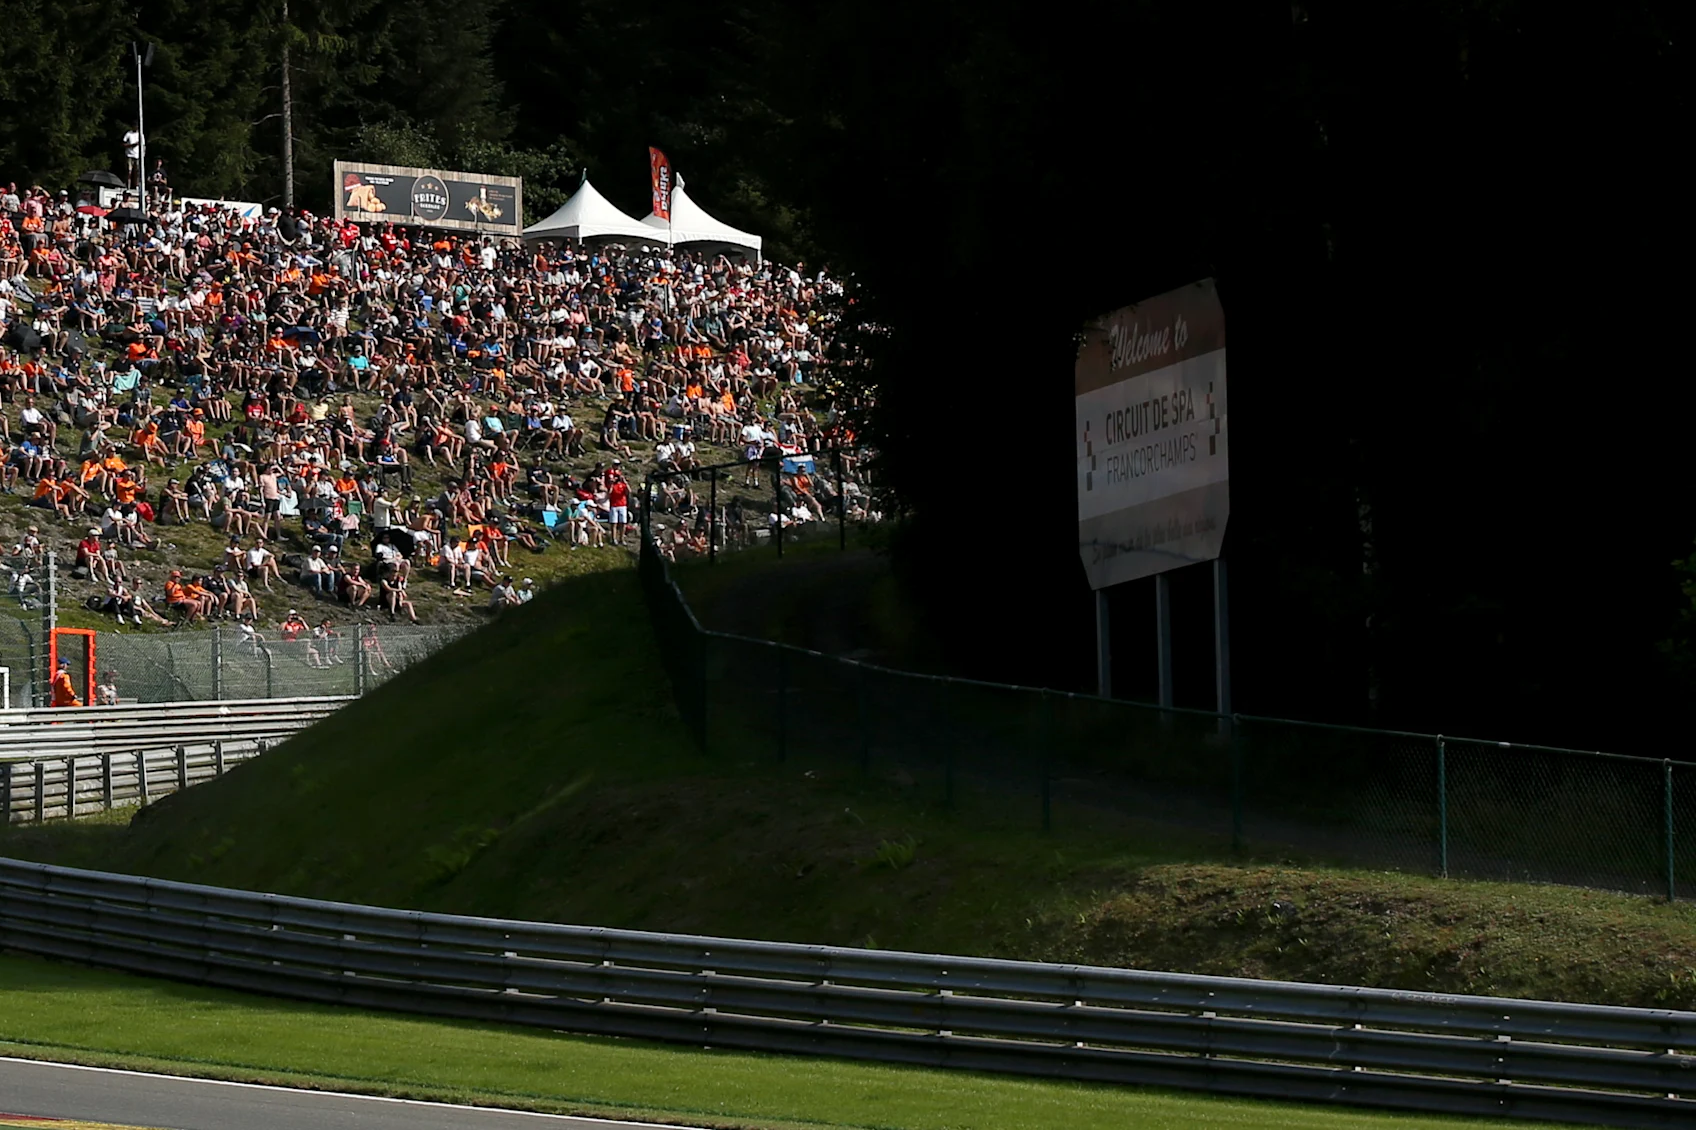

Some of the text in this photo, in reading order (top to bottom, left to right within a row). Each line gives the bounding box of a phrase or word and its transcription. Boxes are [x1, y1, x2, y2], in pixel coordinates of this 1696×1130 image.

[413, 193, 446, 206] FRITES
[1110, 314, 1189, 371] Welcome to
[1106, 388, 1195, 446] CIRCUIT DE SPA
[1107, 432, 1196, 486] FRANCORCHAMPS
